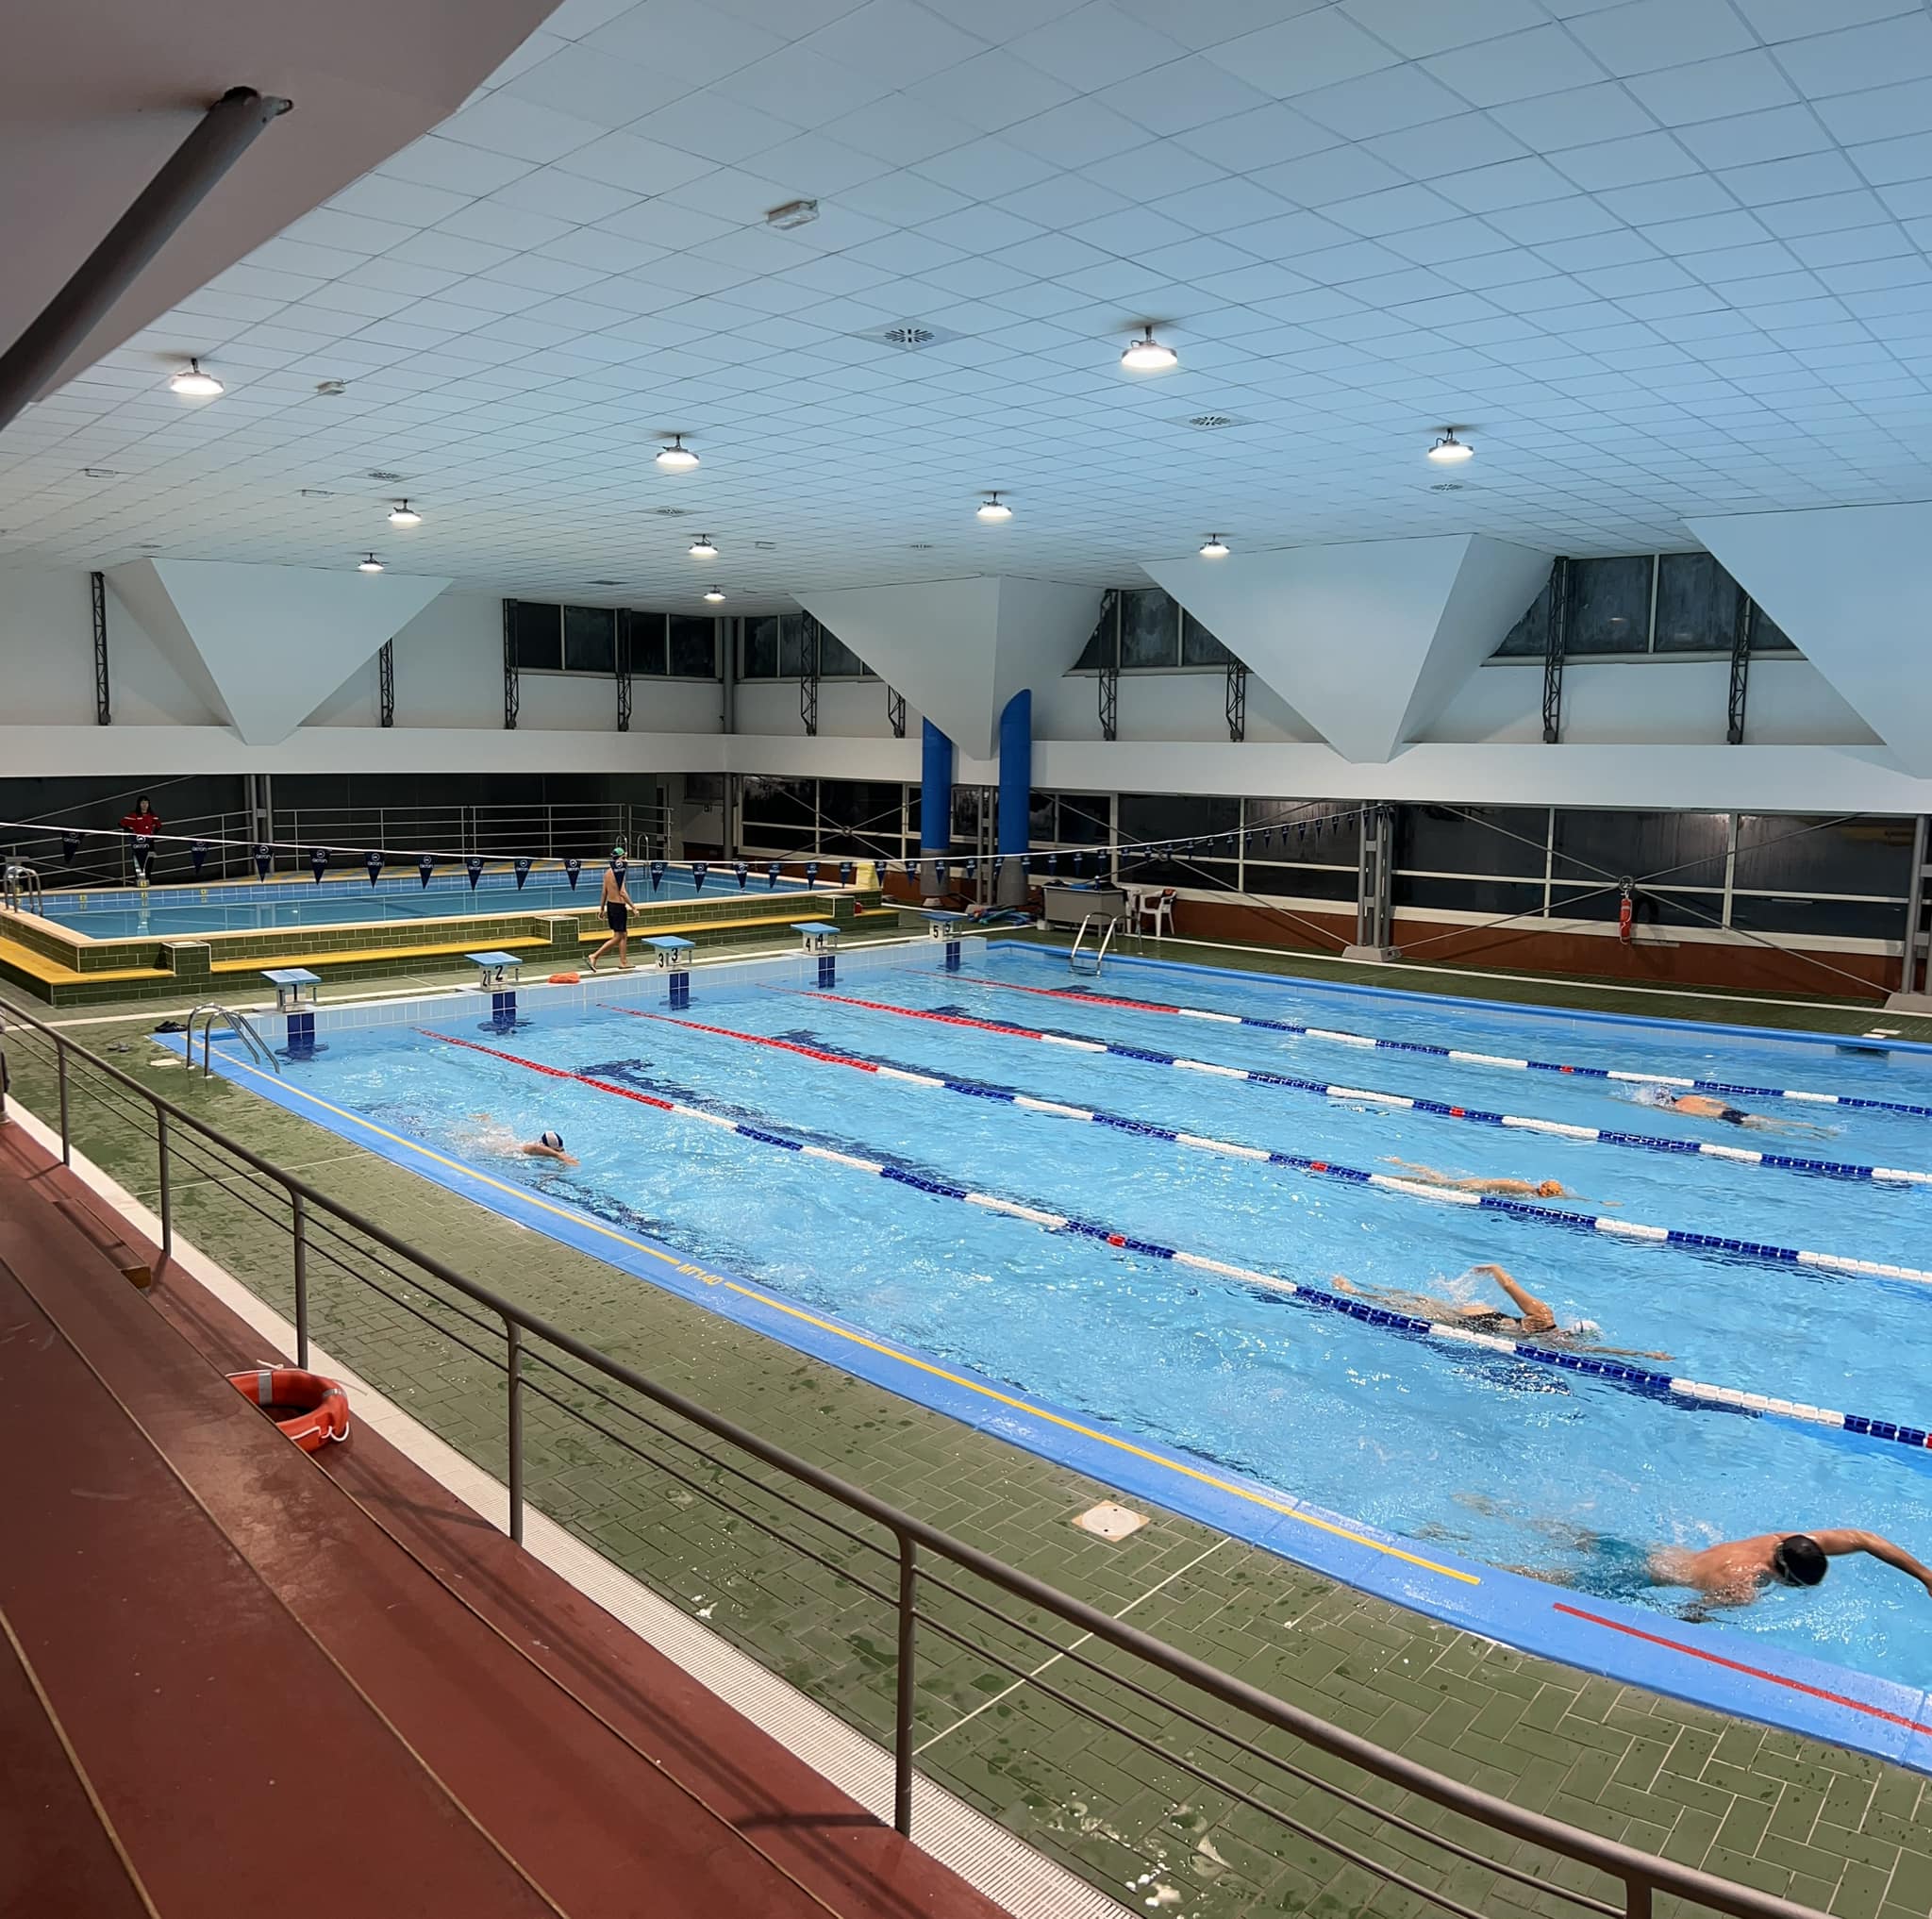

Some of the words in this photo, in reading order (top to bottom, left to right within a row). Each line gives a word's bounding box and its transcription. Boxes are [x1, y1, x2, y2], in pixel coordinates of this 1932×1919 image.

[933, 925, 940, 939] 5
[806, 938, 811, 952] 4
[658, 953, 664, 968] 3
[671, 947, 679, 961] 3
[482, 970, 488, 988] 2
[494, 965, 504, 981] 2
[291, 983, 298, 1003] 1
